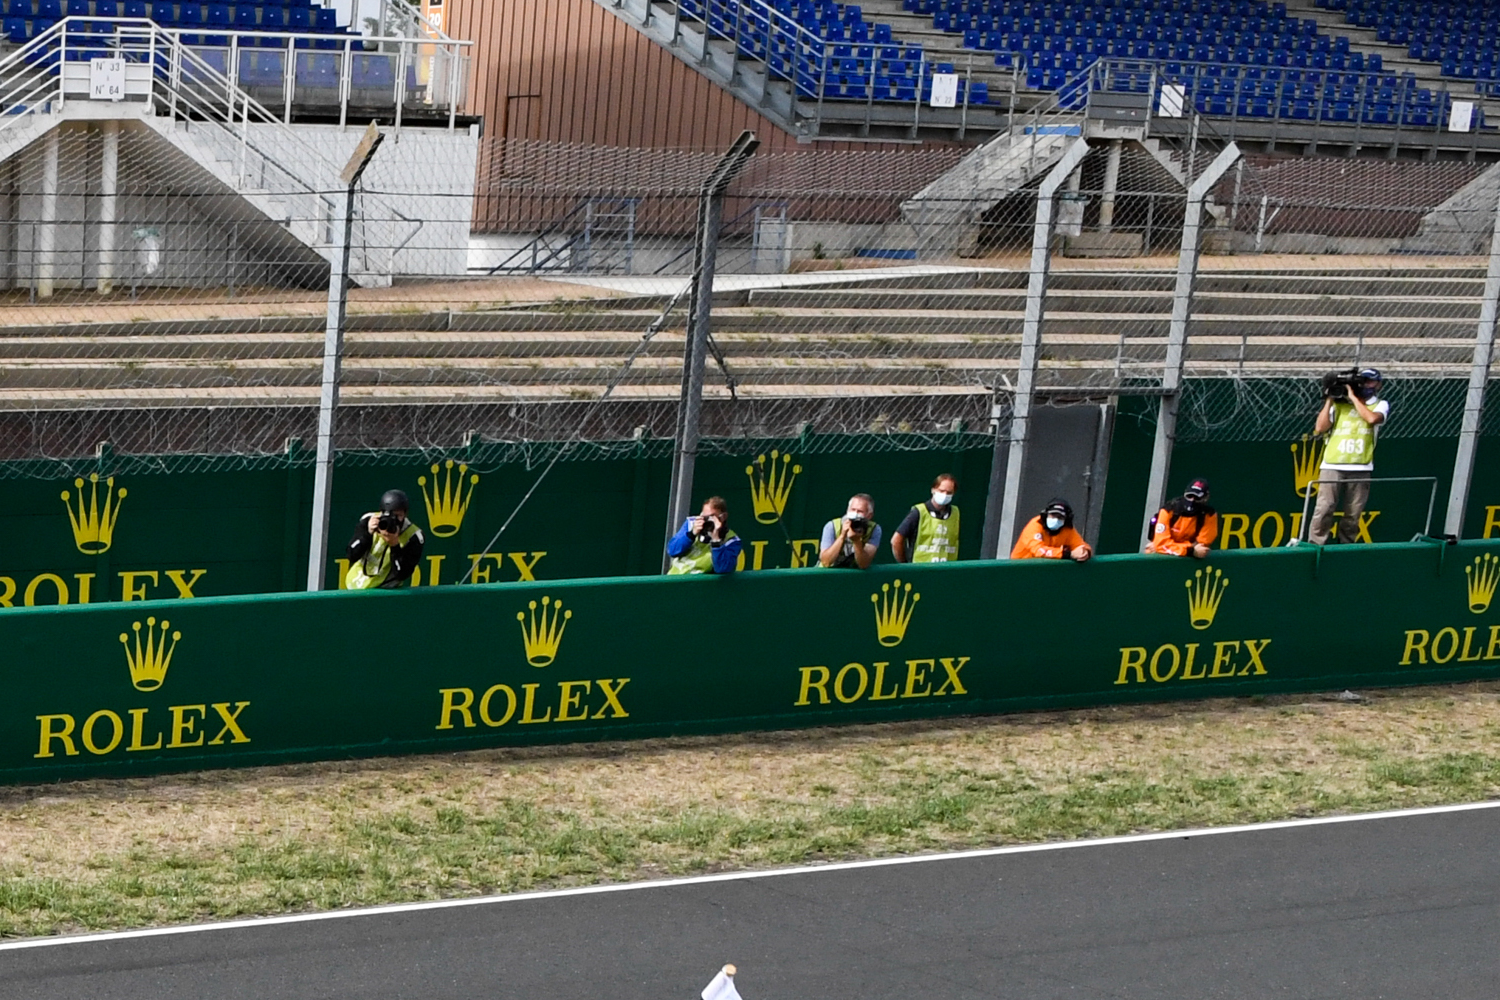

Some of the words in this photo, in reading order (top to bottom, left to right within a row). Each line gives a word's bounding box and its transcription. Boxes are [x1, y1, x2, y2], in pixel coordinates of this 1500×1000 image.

[1337, 439, 1365, 454] 463
[794, 656, 971, 707] ROLEX
[1113, 638, 1272, 685] ROLEX
[435, 677, 632, 731] ROLEX
[33, 701, 252, 759] ROLEX
